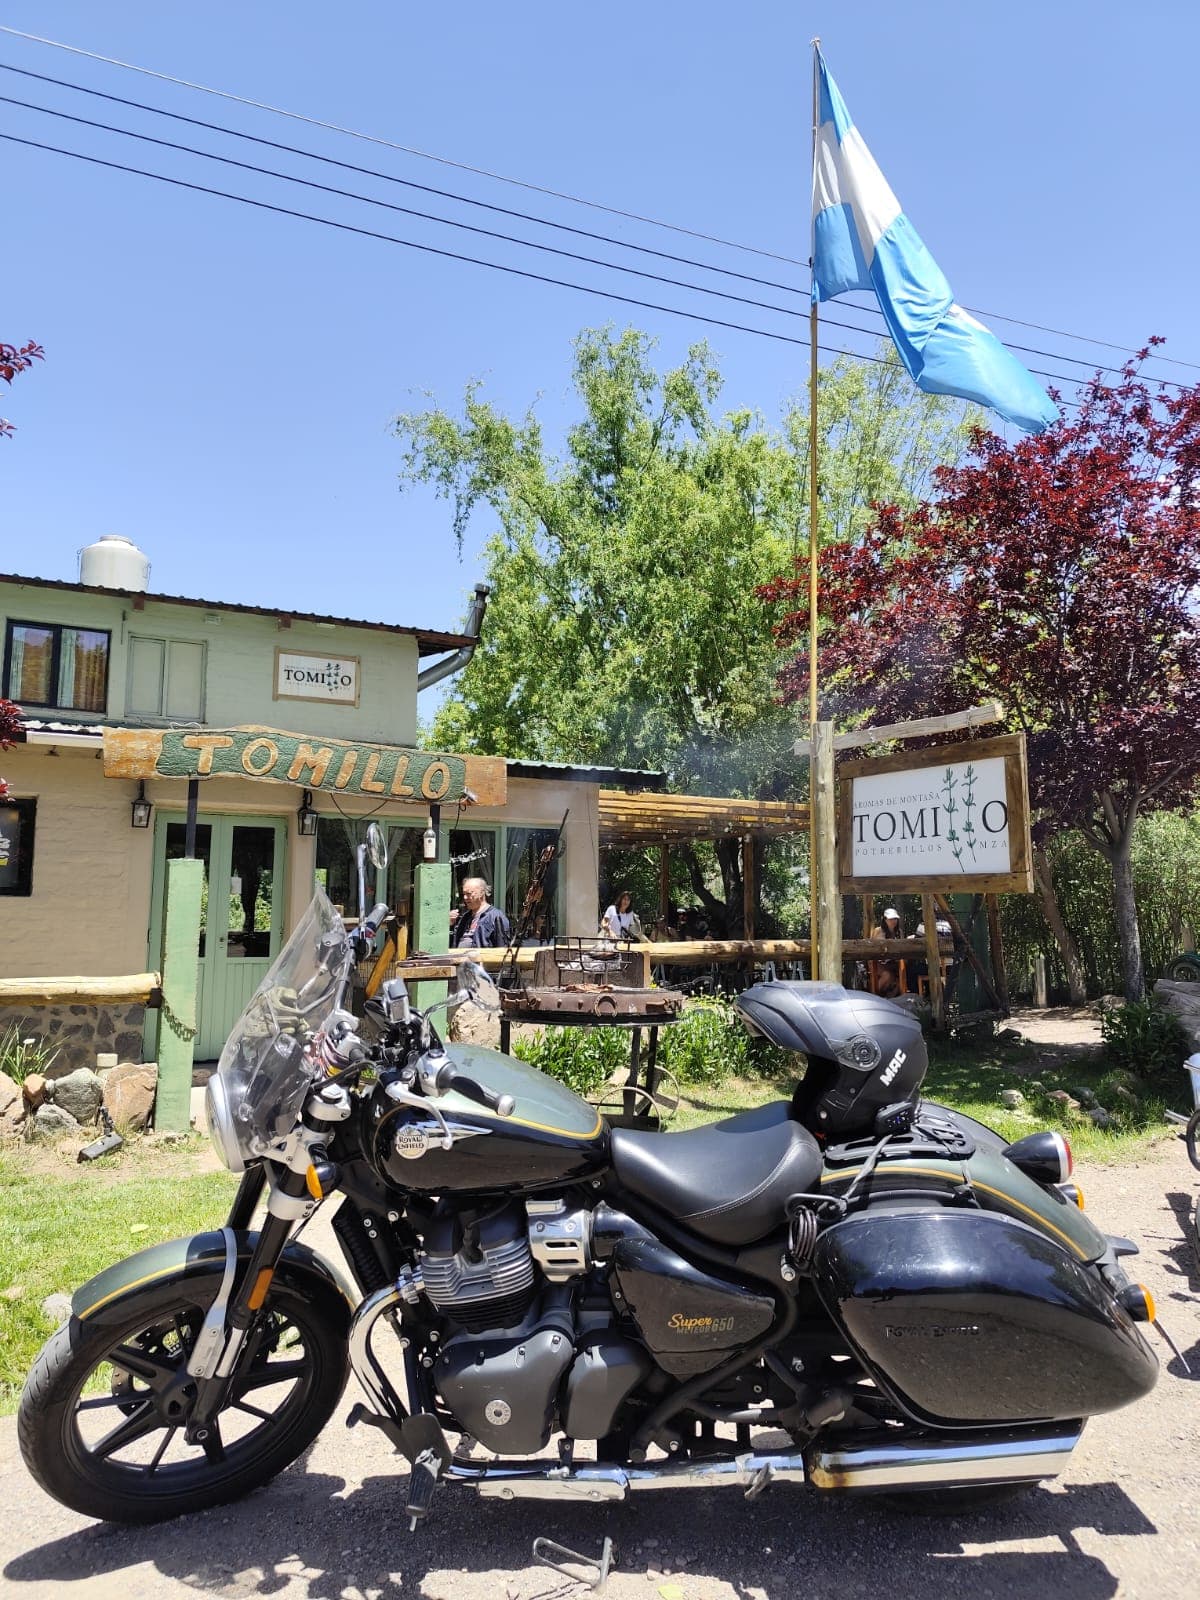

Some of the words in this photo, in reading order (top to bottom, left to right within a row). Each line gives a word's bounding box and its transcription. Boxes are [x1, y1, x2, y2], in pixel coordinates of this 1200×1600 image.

[183, 734, 451, 800] TOMILLO
[854, 800, 884, 809] AROMAS
[901, 792, 940, 803] MONTAÑA
[979, 839, 1008, 849] MZA
[880, 1048, 907, 1087] MAC
[399, 1135, 422, 1143] ROYAL
[668, 1313, 713, 1329] Super
[711, 1316, 734, 1332] 650
